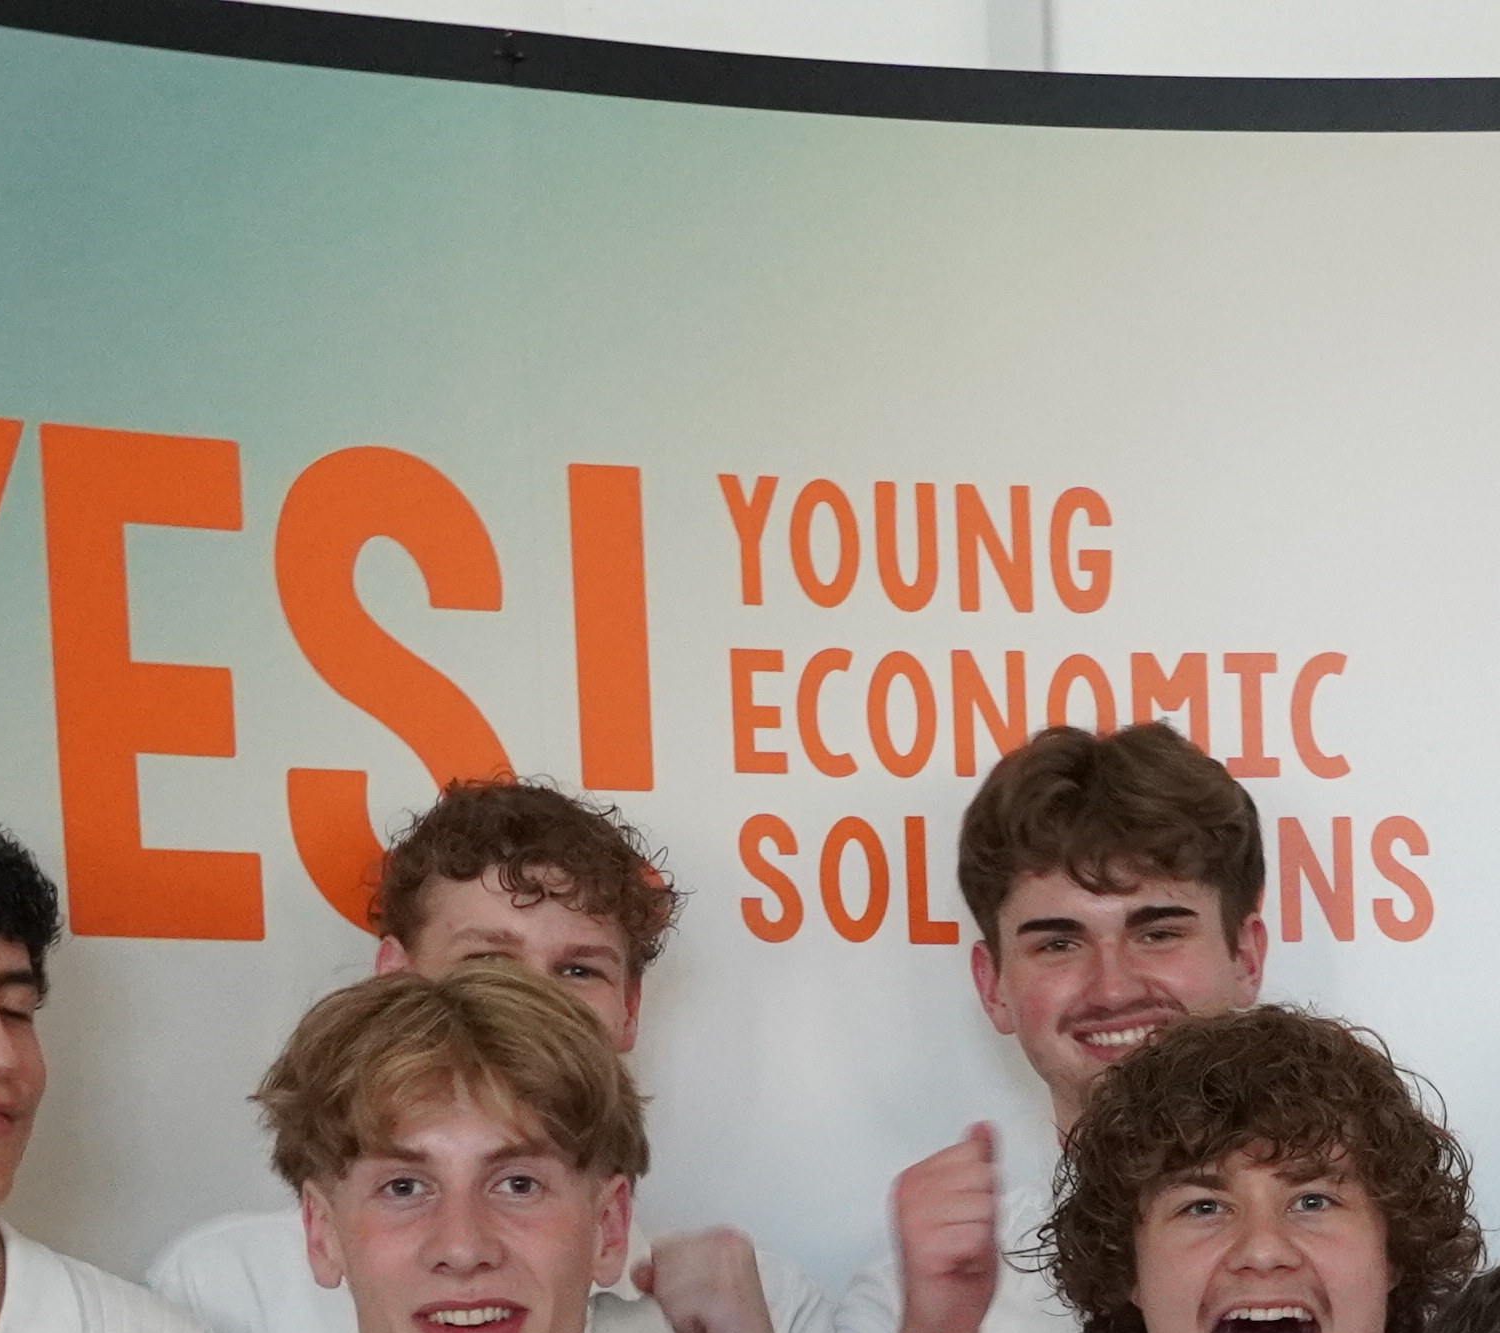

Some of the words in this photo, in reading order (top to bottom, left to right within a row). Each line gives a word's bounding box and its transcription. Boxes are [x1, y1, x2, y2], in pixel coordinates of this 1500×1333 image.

[717, 473, 1113, 613] YOUNG
[729, 647, 1352, 780] ECONOMIC
[738, 815, 1435, 943] SOLNS
